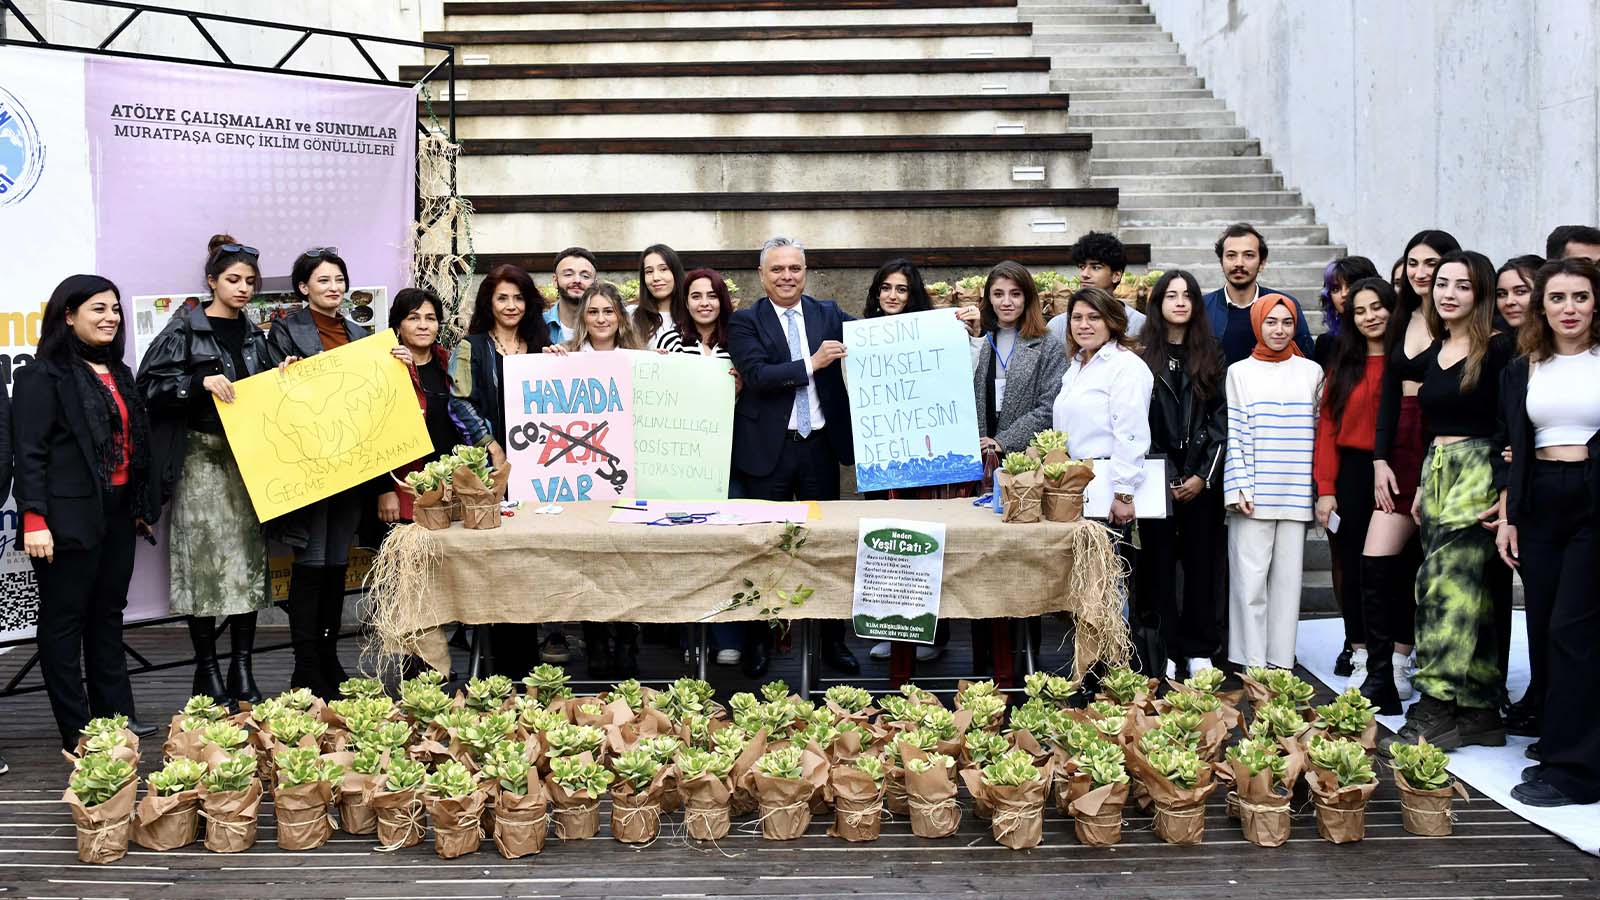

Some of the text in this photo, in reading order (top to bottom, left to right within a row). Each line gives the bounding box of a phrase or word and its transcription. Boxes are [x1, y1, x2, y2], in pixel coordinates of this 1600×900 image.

[110, 103, 397, 139] ATÖLYE ÇALIŞMALARI ve SUNUMLAR
[114, 124, 395, 156] MURATPAŞA GENÇ İKLİM GÖNÜLLÜLERİ
[855, 317, 920, 348] SESİNİ
[855, 348, 945, 379] YÜKSELT
[521, 376, 624, 414] HAVADA
[857, 378, 921, 408] DENİZ
[860, 400, 958, 439] SEVİYESİNİ
[530, 473, 593, 503] VAR
[871, 537, 932, 554] Yeşil Çatı ?
[892, 531, 912, 540] Neden
